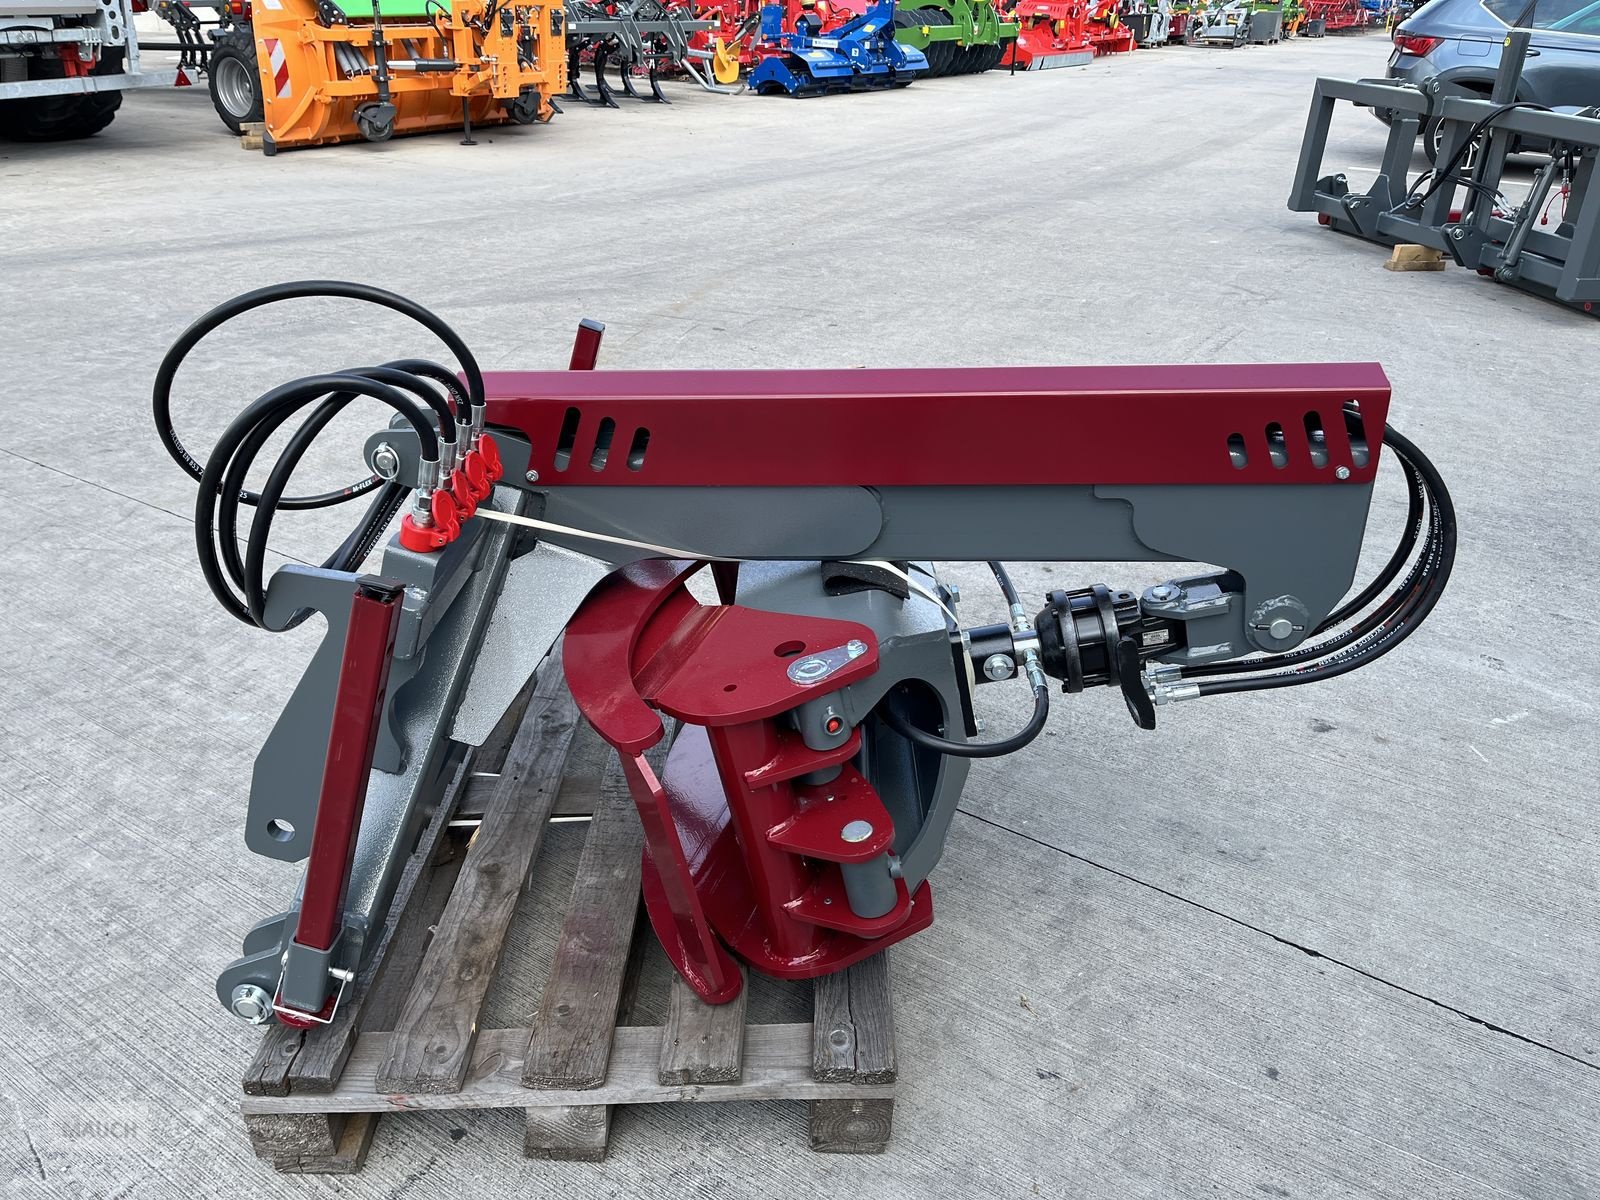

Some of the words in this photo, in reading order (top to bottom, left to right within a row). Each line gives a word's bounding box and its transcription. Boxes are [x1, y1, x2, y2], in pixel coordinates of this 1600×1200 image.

[182, 452, 191, 462] EN
[352, 479, 373, 493] M-FLEX
[1358, 624, 1386, 647] EXCEEDS
